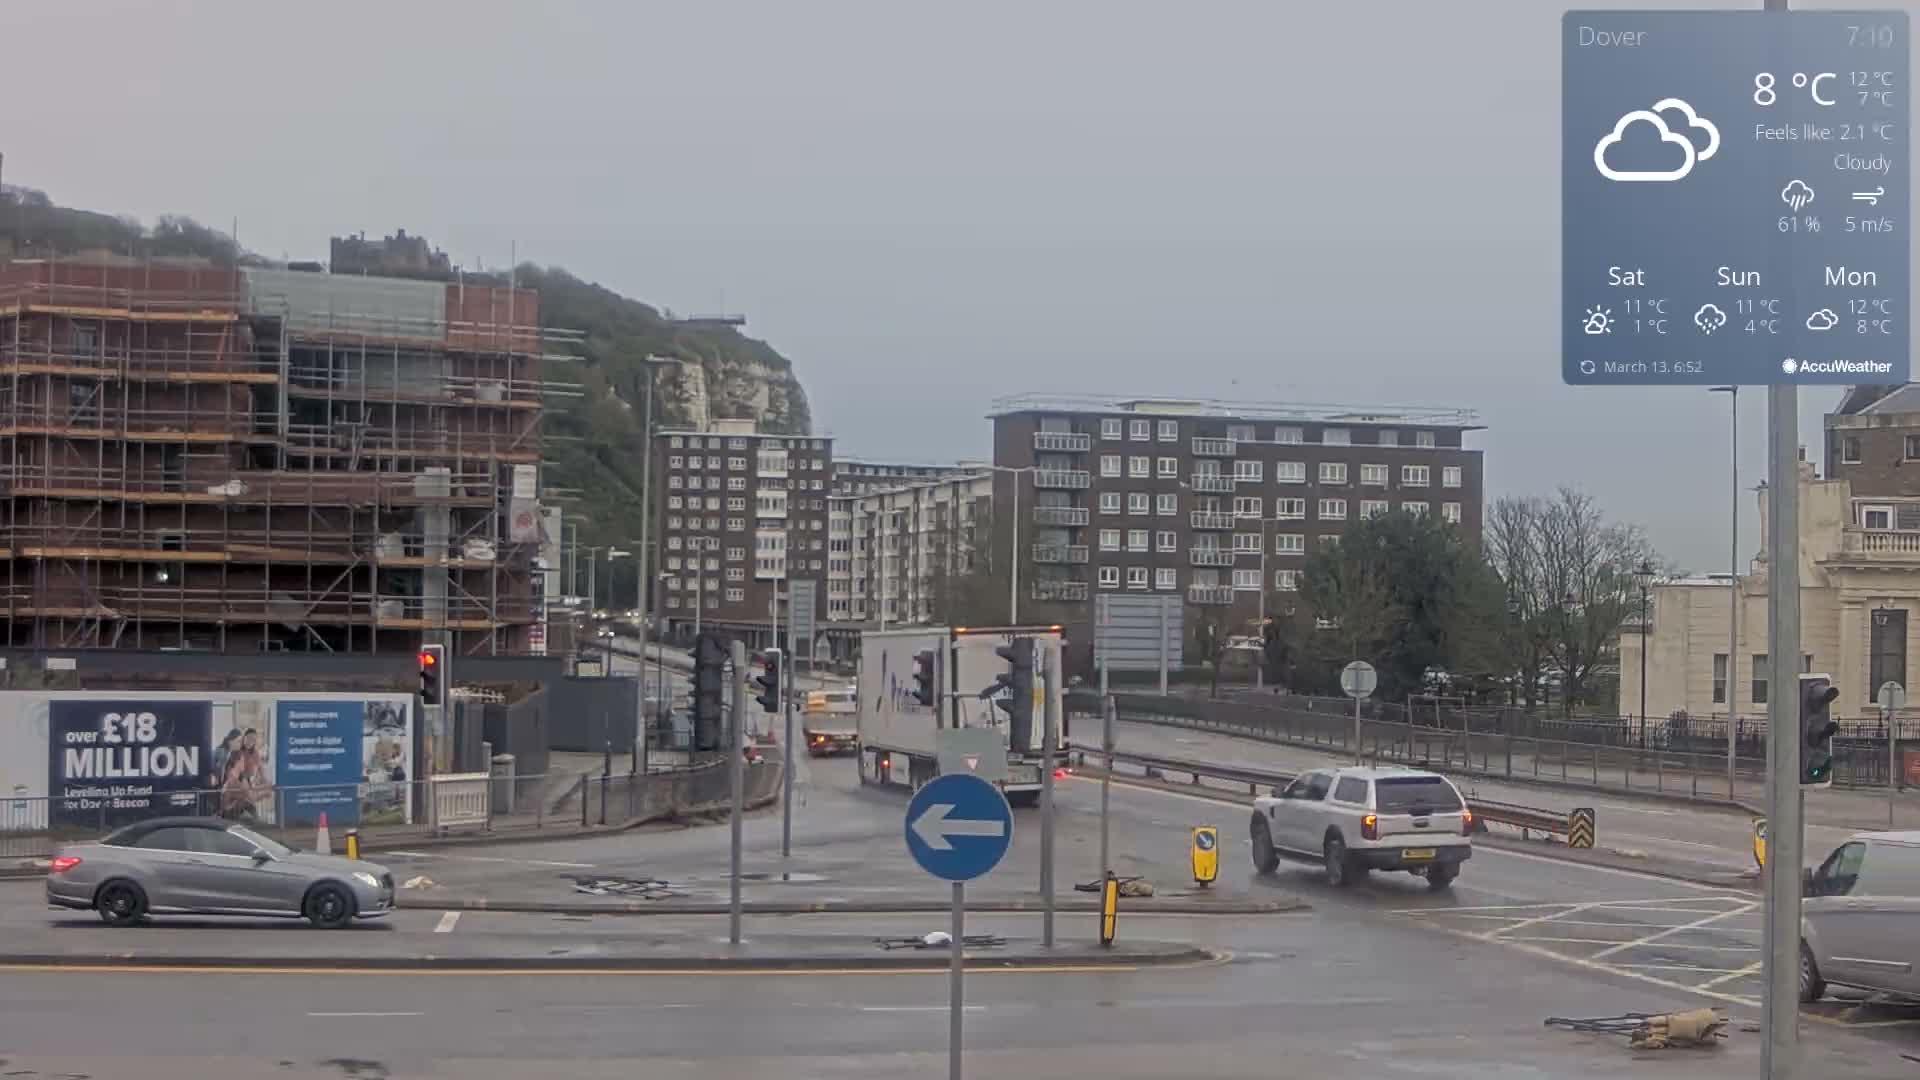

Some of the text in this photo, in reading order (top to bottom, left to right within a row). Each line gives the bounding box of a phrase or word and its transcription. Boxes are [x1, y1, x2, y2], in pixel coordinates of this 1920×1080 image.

[66, 712, 157, 743] over £18
[65, 746, 198, 778] MILLION
